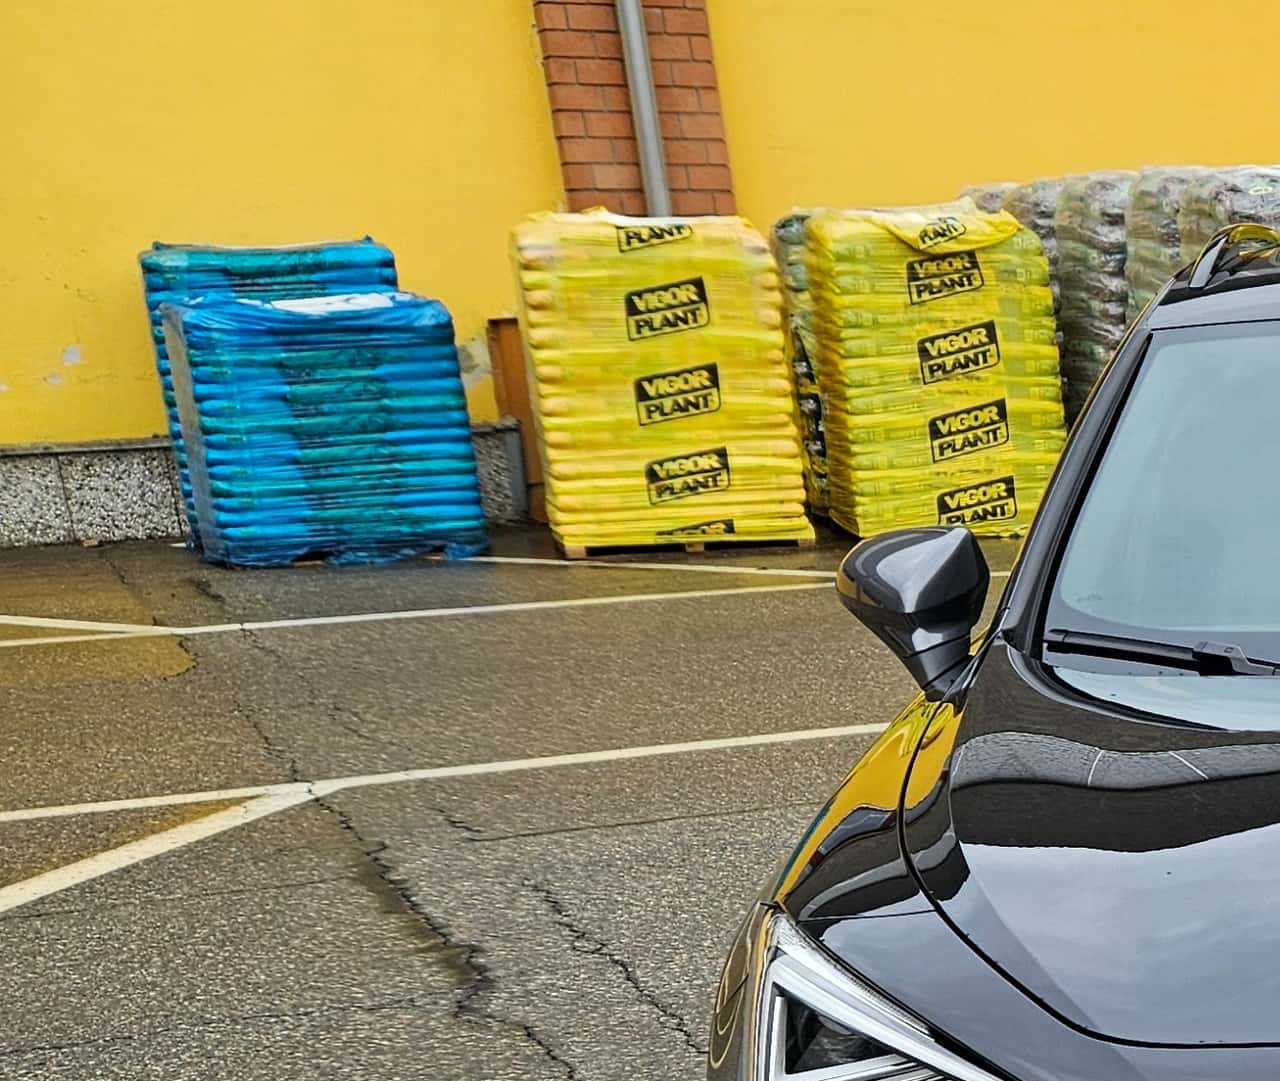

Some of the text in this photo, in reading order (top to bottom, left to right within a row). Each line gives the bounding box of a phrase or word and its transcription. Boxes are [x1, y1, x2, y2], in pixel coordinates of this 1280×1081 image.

[623, 223, 686, 247] PLANT
[912, 253, 973, 278] VIGOR
[631, 283, 701, 313] VIGOR
[915, 272, 975, 298] PLANT
[634, 306, 702, 336] PLANT
[924, 327, 990, 358] VIGOR
[927, 349, 991, 379] PLANT
[641, 368, 713, 398] VIGOR
[644, 392, 713, 420] PLANT
[935, 405, 1001, 435] VIGOR
[938, 428, 1002, 458] PLANT
[651, 453, 723, 480] VIGOR
[655, 471, 722, 499] PLANT
[943, 482, 1009, 510] VIGOR
[945, 501, 1009, 524] PLANT
